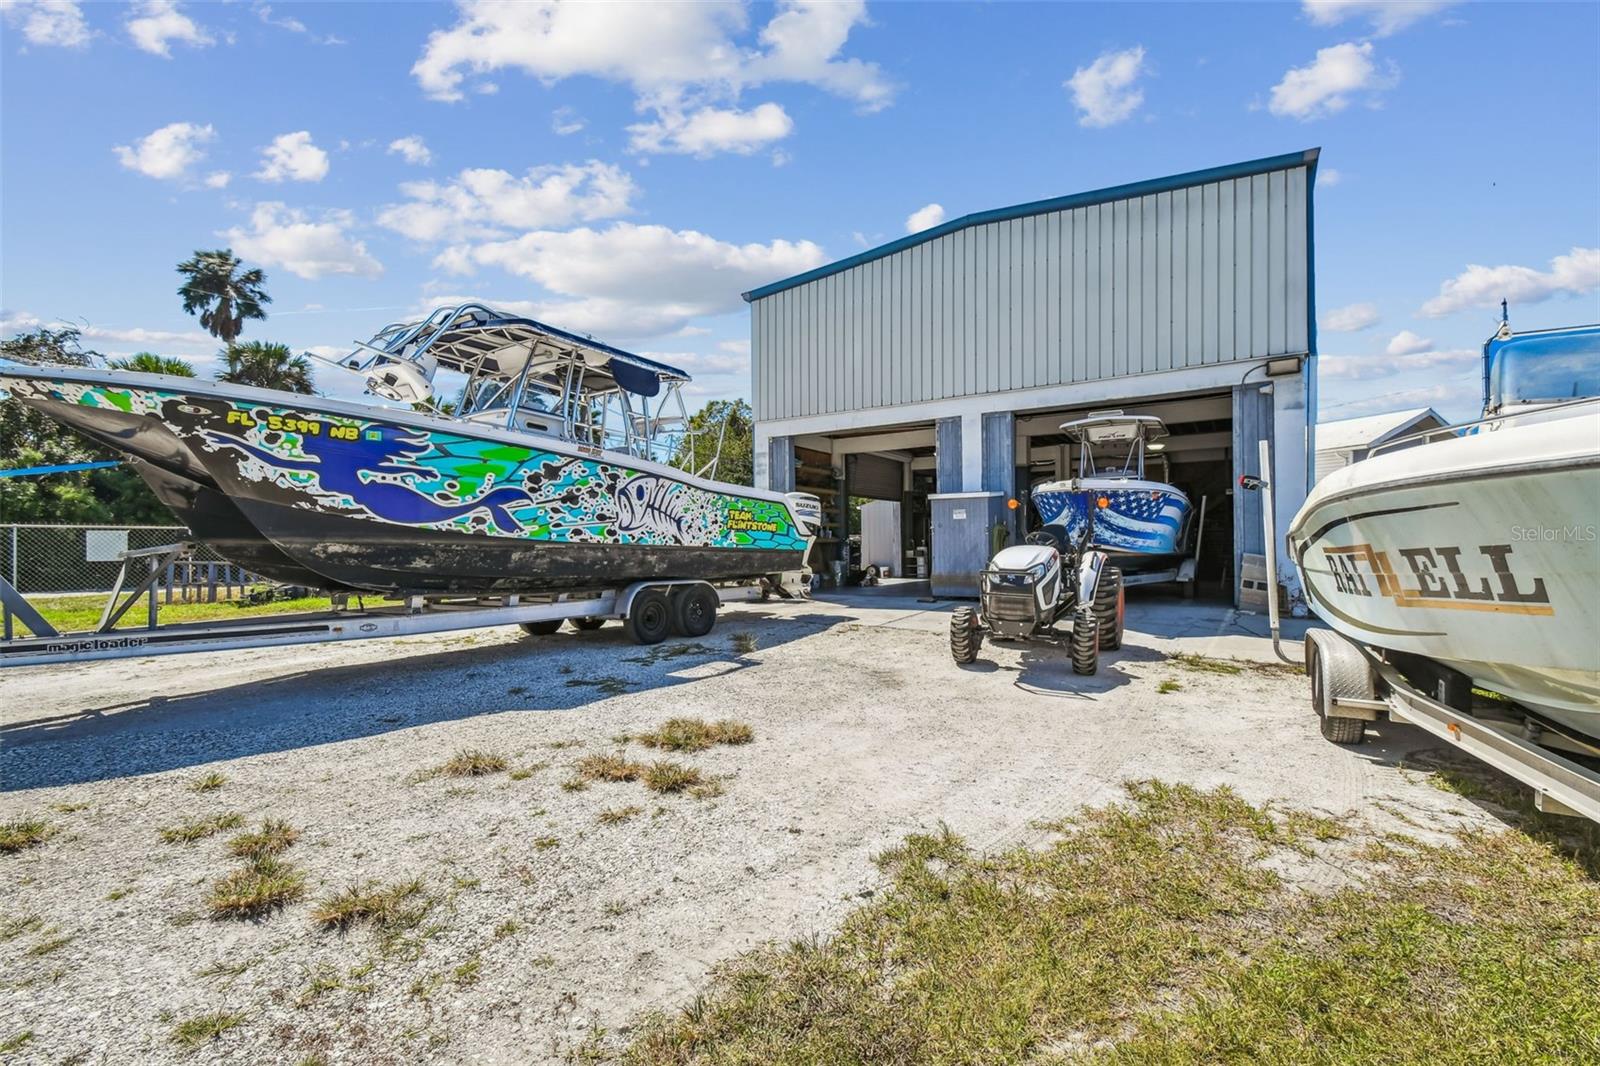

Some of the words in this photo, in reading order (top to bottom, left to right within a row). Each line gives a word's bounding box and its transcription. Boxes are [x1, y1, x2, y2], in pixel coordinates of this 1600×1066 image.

[226, 411, 256, 427] FL
[267, 415, 321, 435] 5399
[329, 426, 360, 441] NB
[794, 502, 820, 511] SUZUKI
[728, 510, 753, 520] TEAM
[727, 520, 778, 533] FLINTSTONE
